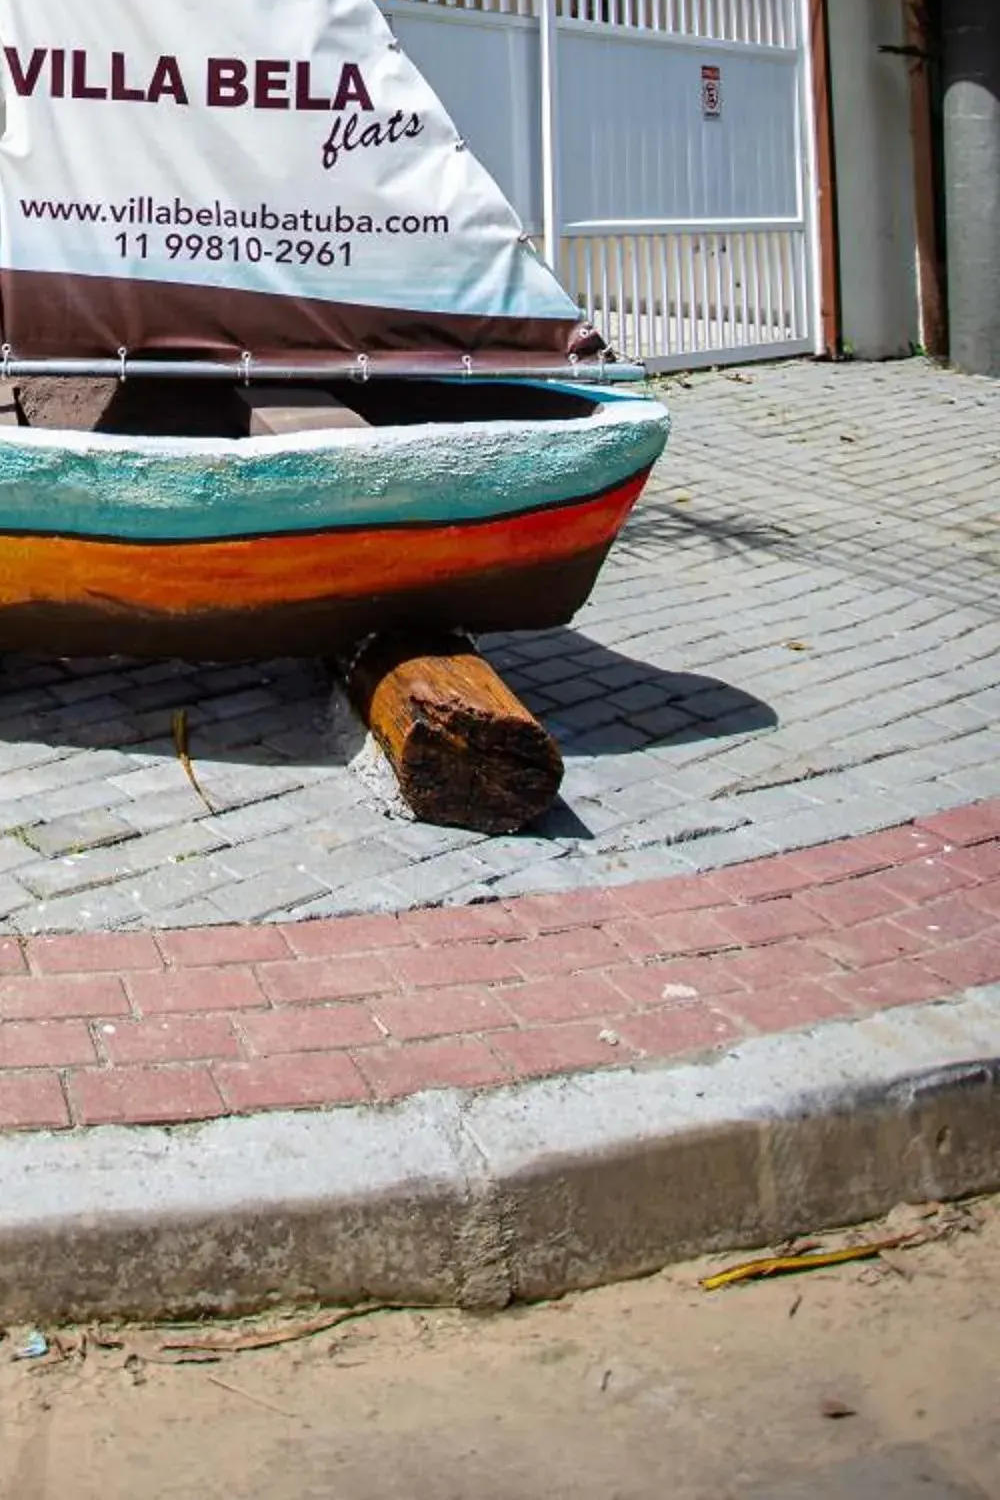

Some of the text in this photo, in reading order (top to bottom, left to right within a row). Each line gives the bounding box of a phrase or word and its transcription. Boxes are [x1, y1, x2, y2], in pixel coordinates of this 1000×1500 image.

[3, 46, 375, 112] VILLA BELA
[322, 109, 425, 170] flats
[20, 196, 450, 234] www.villabelaubatuba.com
[114, 232, 353, 267] 11 99810-2961
